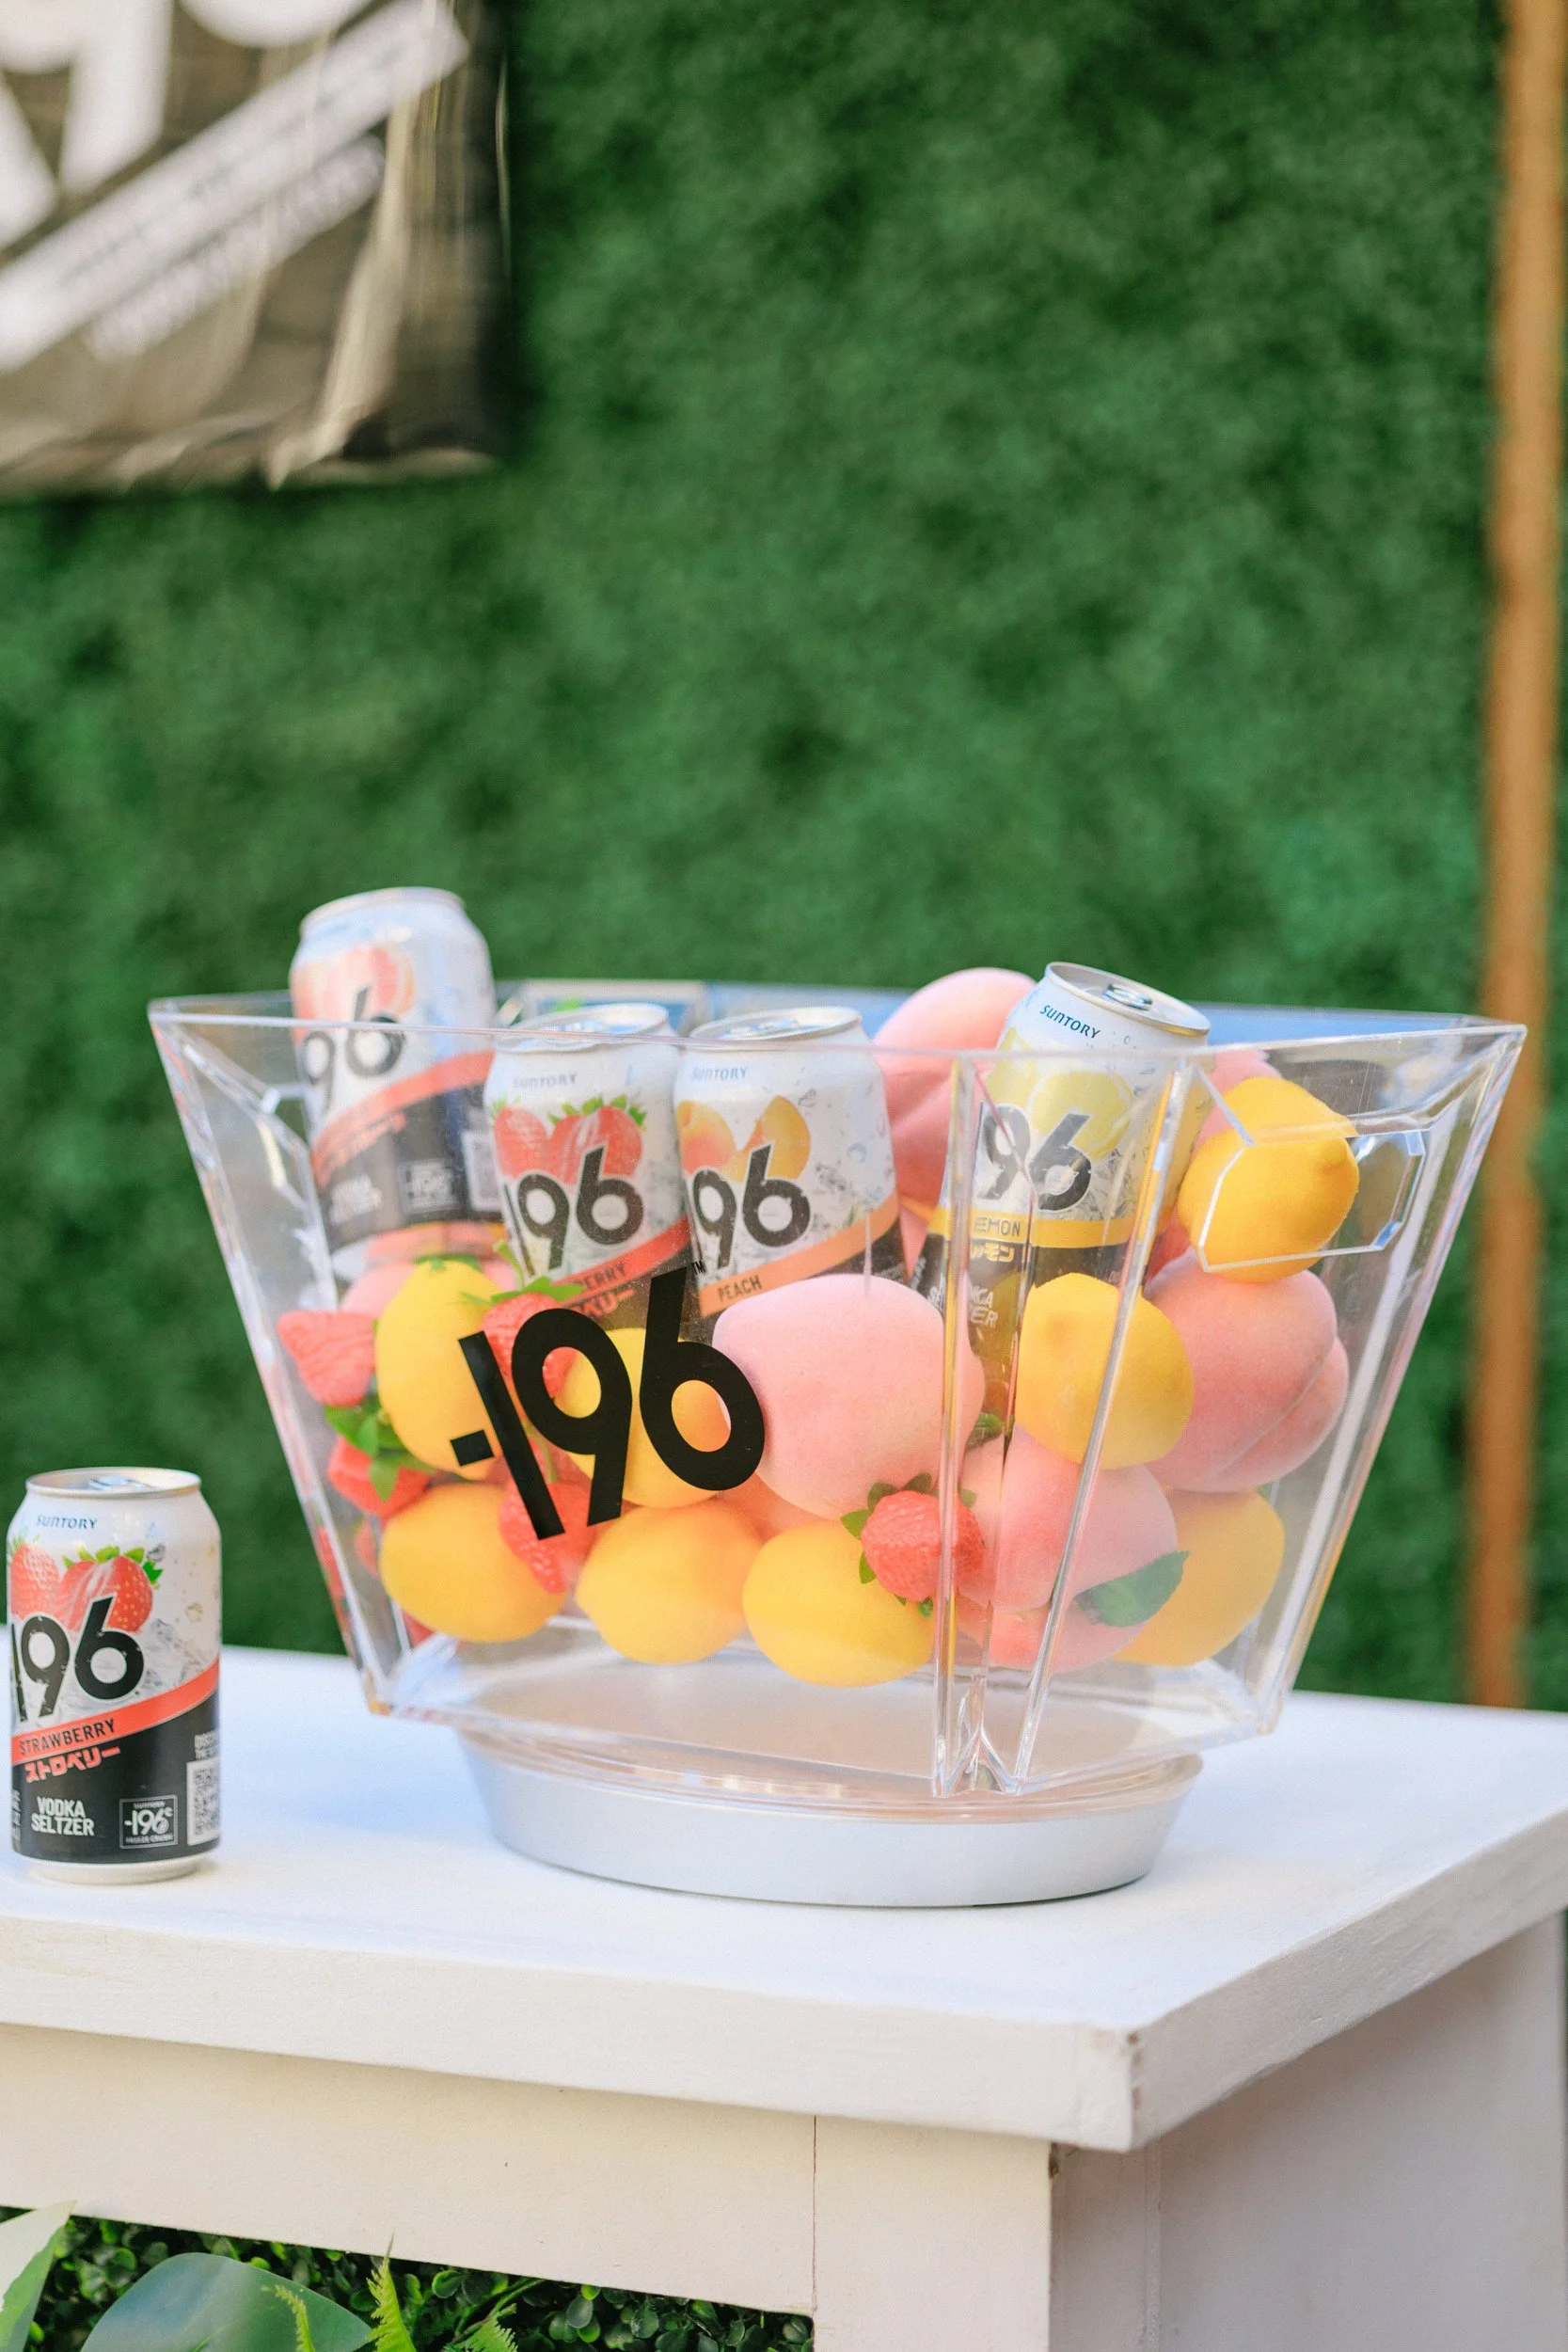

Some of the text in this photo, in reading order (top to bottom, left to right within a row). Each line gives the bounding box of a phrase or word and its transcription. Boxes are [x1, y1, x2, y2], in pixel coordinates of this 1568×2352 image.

[1039, 1004, 1101, 1040] SUNTORY
[300, 983, 407, 1114] 96
[973, 1216, 1022, 1238] EMON
[717, 1274, 763, 1303] PEACH
[450, 1266, 766, 1541] -196
[35, 1512, 98, 1530] SUNTORY
[19, 1717, 116, 1756] STRAWBERRY
[24, 1745, 121, 1784] ストロベリー
[36, 1795, 87, 1819] VODKA
[30, 1812, 95, 1836] SELTZER
